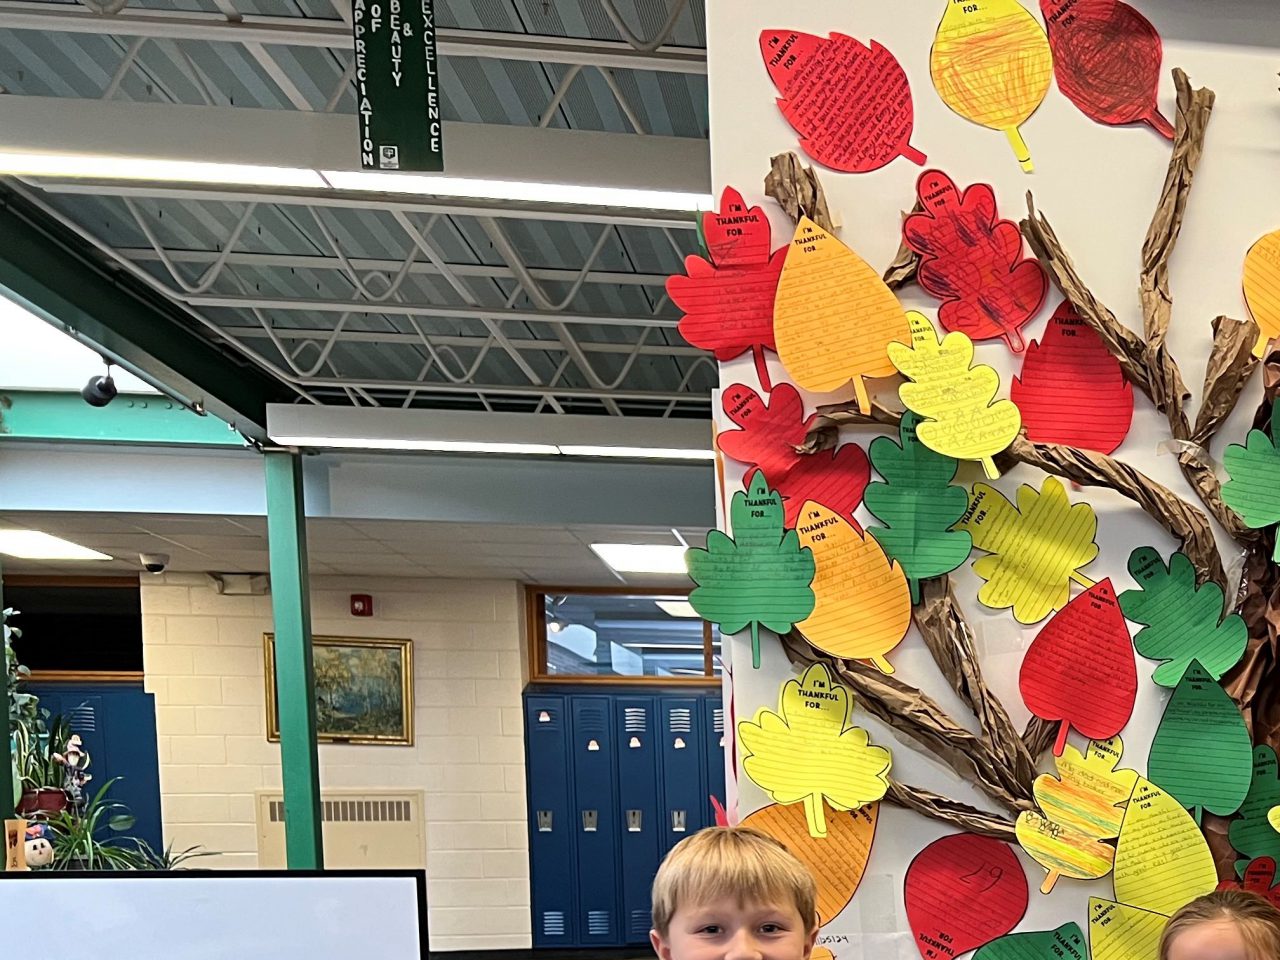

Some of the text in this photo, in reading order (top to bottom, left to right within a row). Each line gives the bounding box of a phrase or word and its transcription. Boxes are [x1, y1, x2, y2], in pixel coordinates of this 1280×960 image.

[768, 36, 780, 49] I'M
[770, 34, 798, 67] THANKFUL
[354, 0, 374, 166] APPRECIATION
[371, 4, 381, 33] OF
[390, 0, 402, 87] BEAUTY
[421, 0, 440, 152] EXCELLENCE
[795, 233, 827, 245] THANKFUL
[808, 511, 820, 519] I'M
[800, 517, 838, 534] THANKFUL
[798, 690, 838, 701] THANKFUL
[920, 933, 955, 956] THANKFUL
[1070, 934, 1080, 945] I'M
[926, 950, 938, 959] I'M
